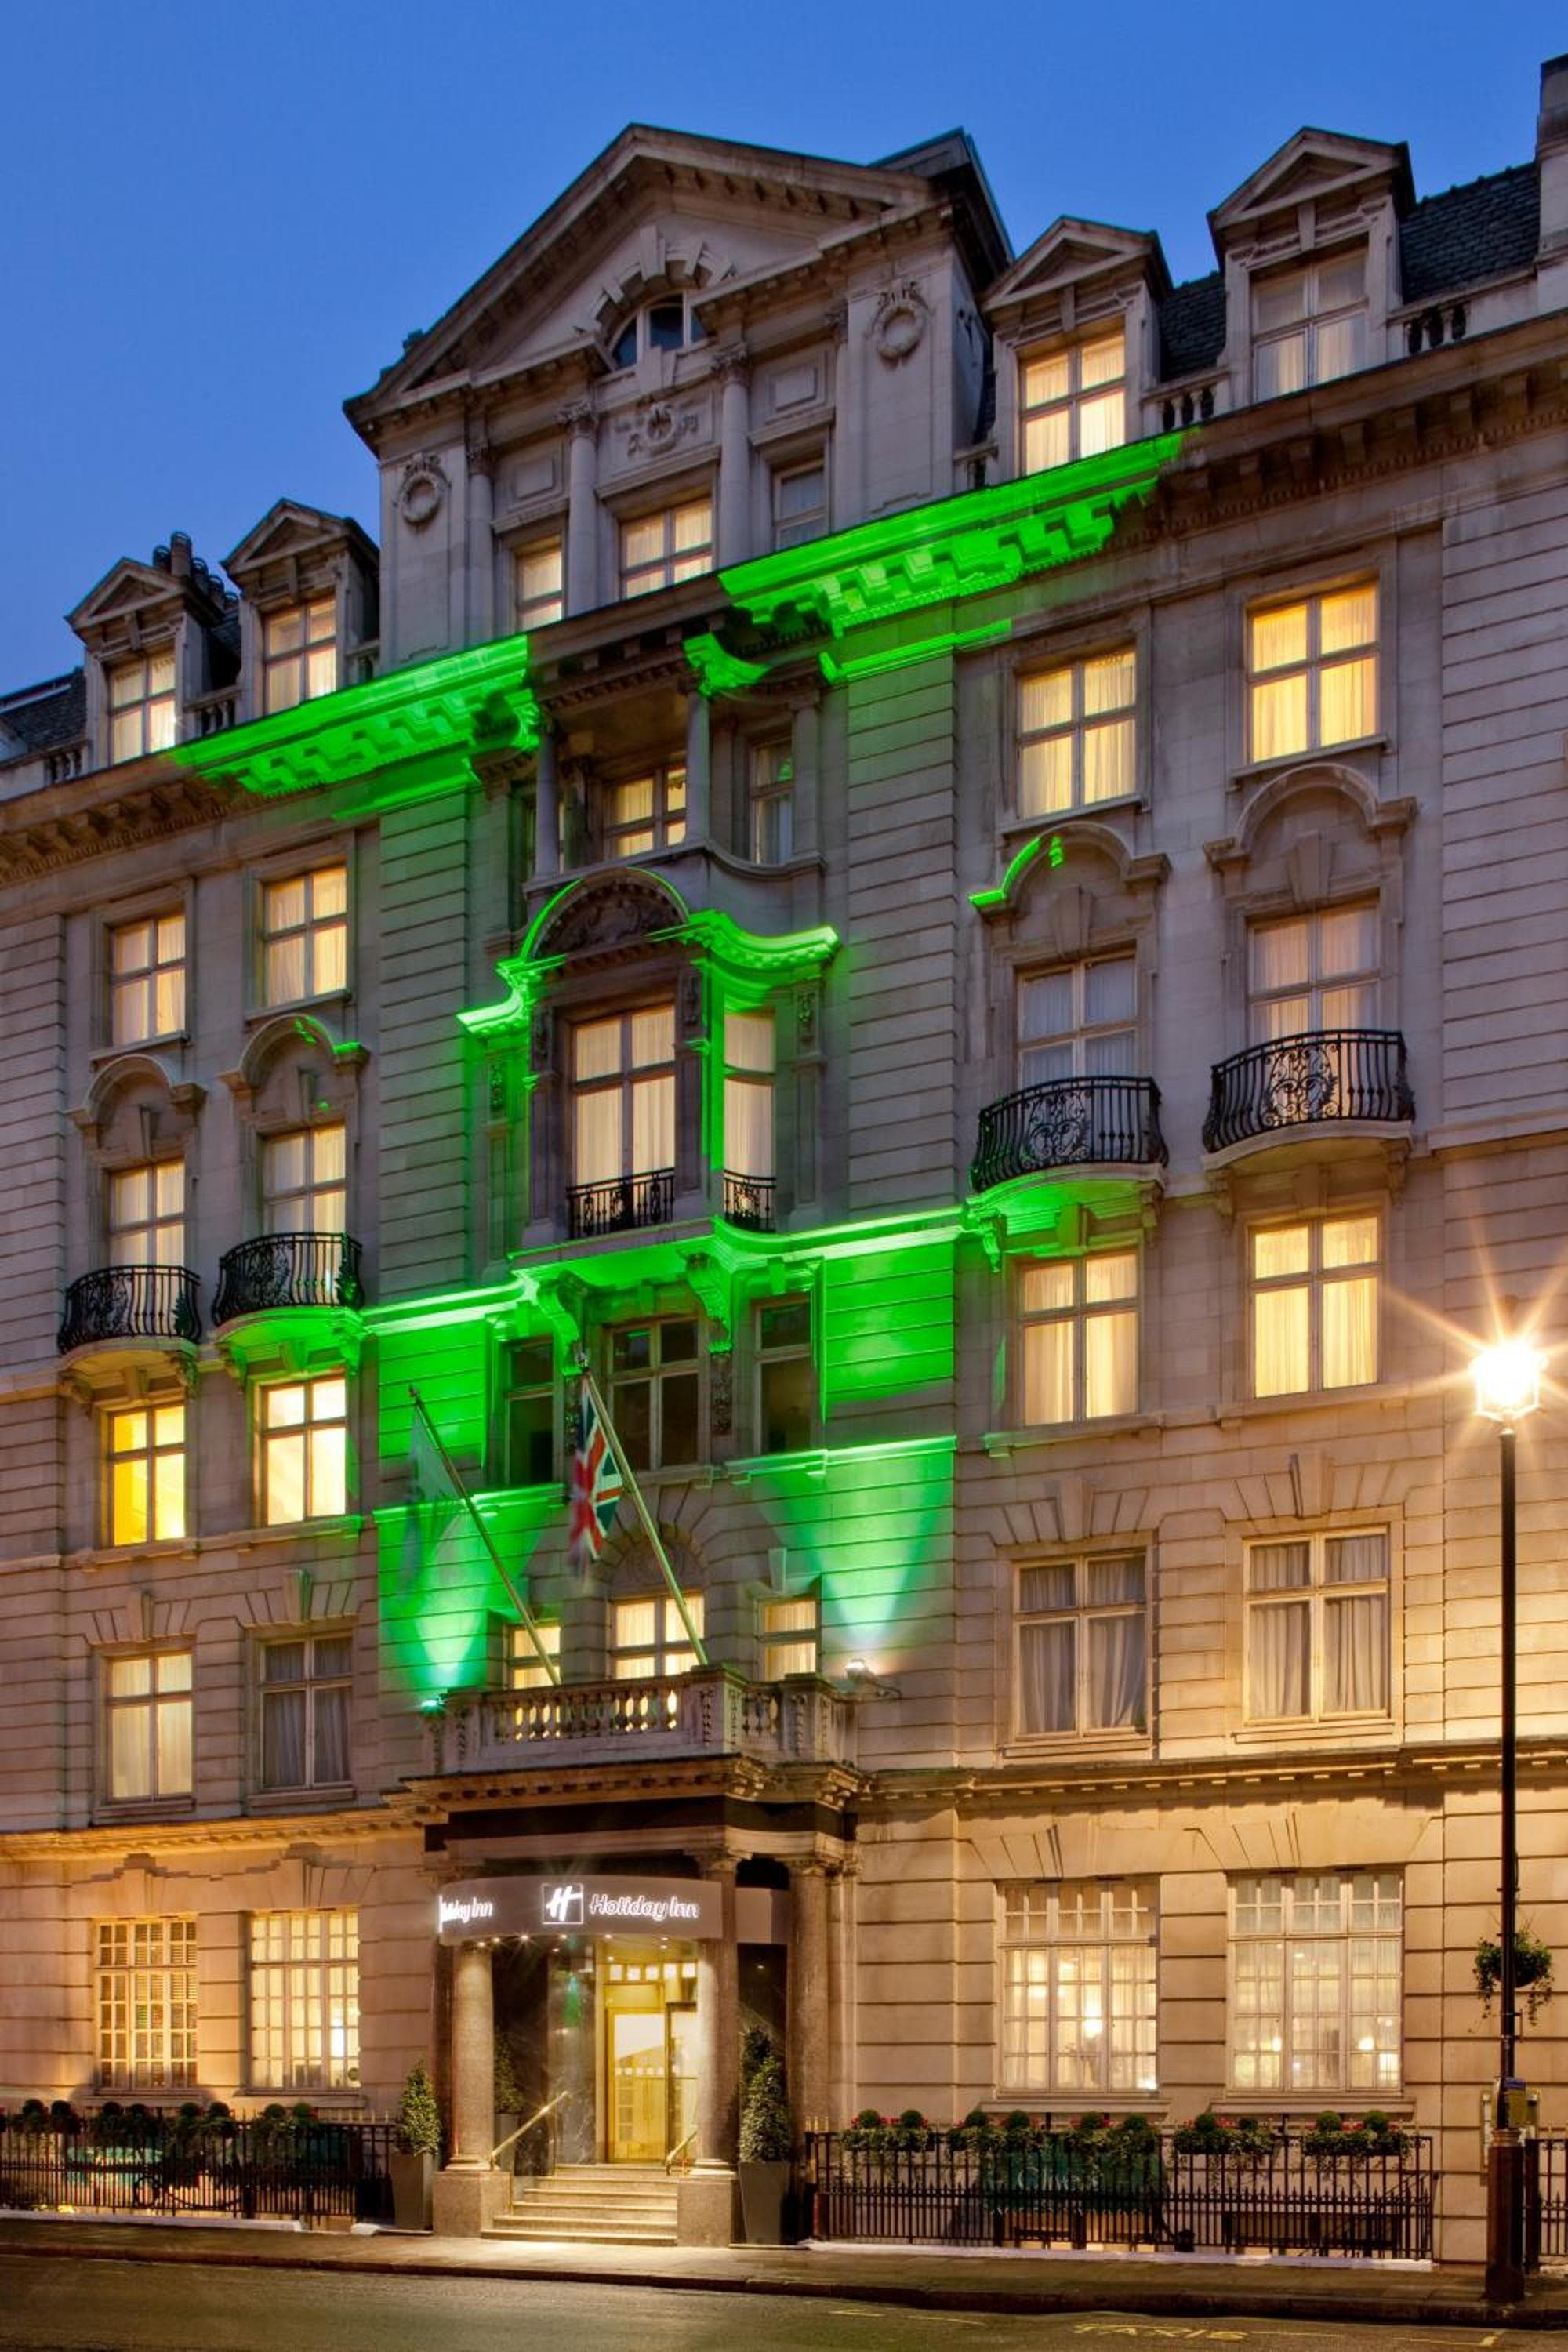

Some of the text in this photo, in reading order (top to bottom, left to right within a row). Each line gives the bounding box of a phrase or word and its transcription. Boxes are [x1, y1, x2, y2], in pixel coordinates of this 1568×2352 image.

[472, 1896, 493, 1918] Inn
[590, 1894, 700, 1921] Holiday Inn
